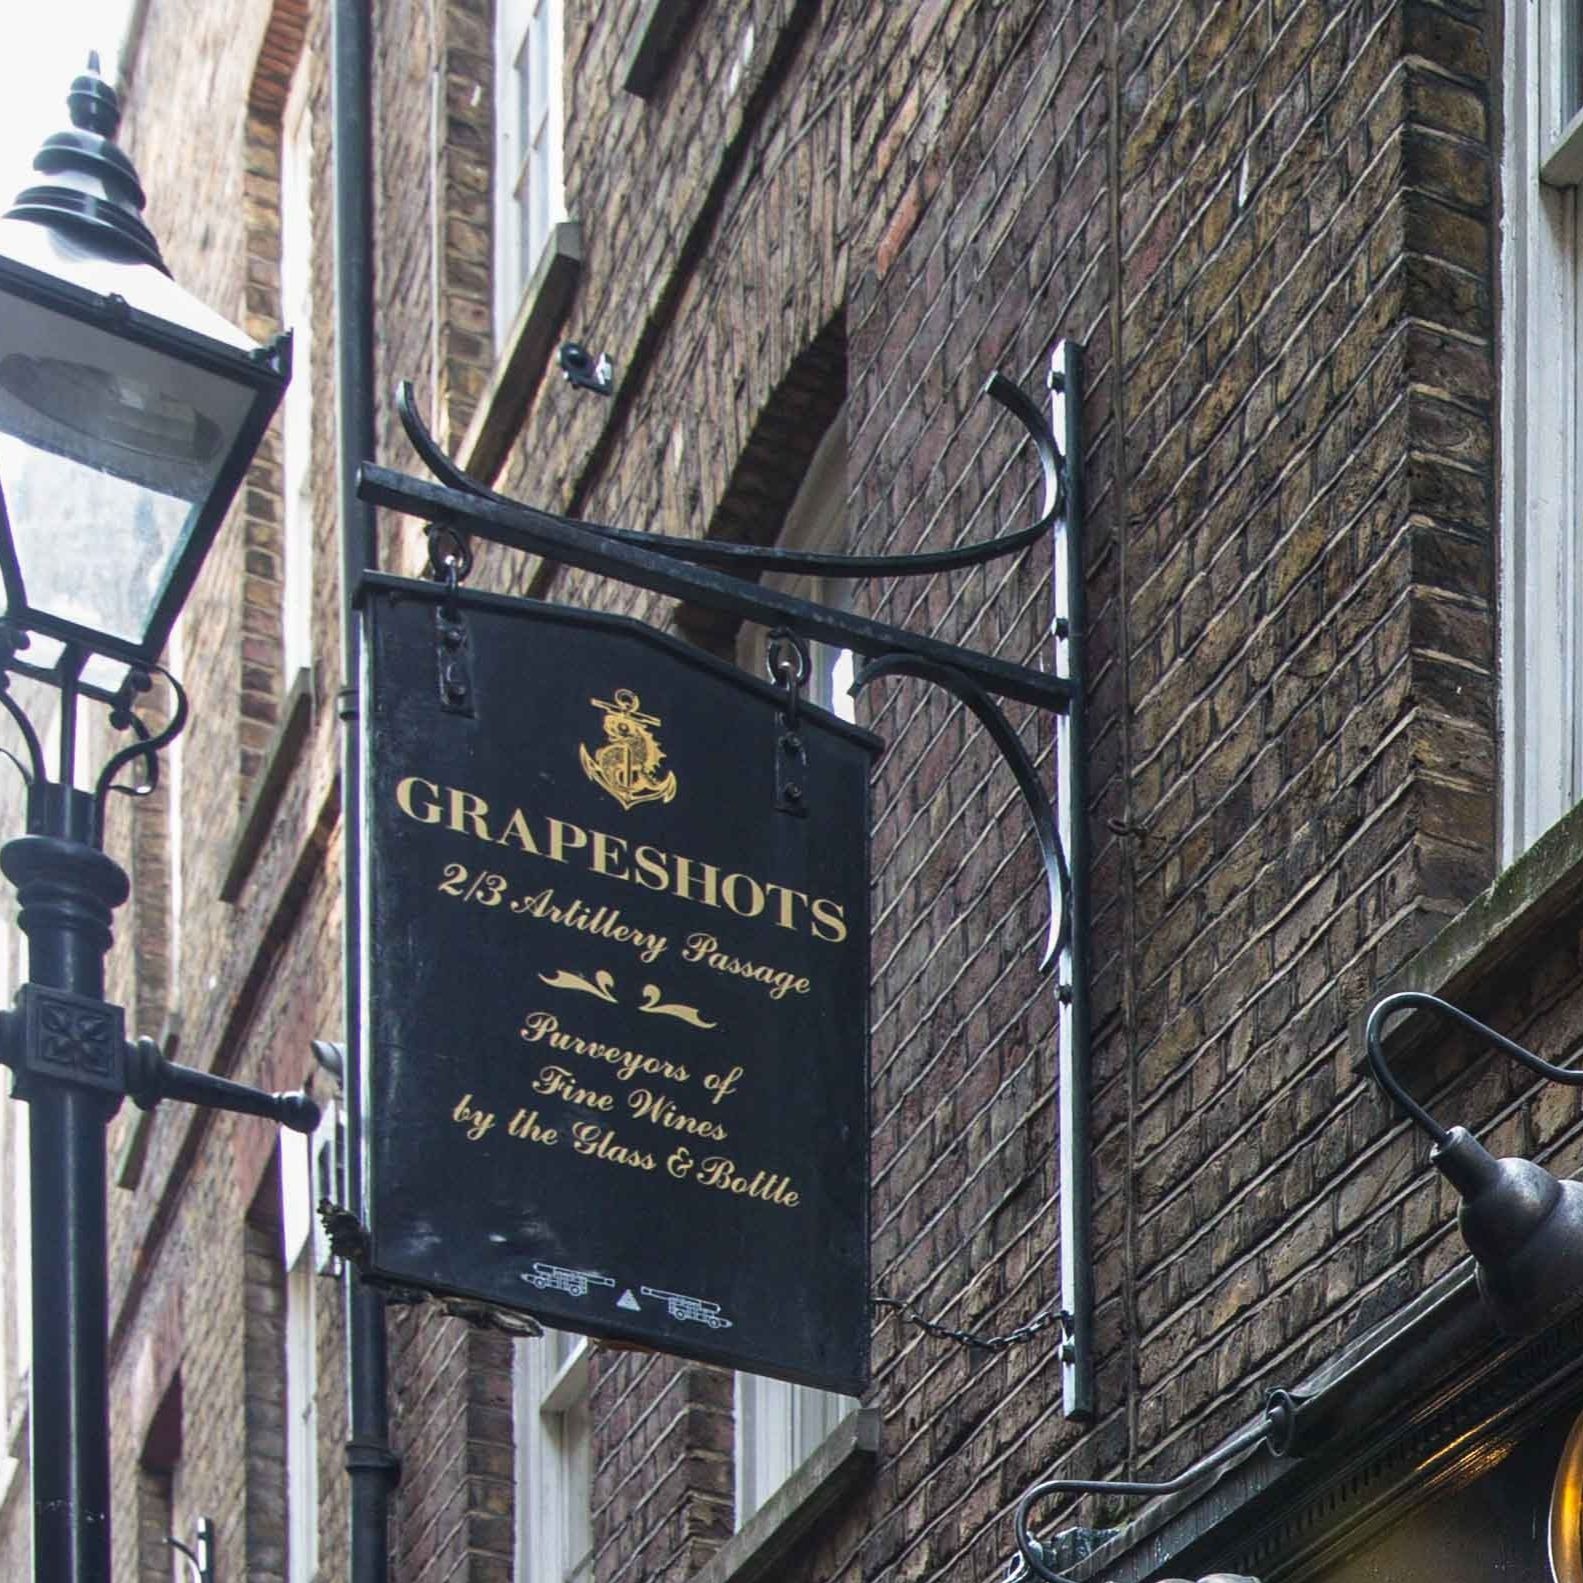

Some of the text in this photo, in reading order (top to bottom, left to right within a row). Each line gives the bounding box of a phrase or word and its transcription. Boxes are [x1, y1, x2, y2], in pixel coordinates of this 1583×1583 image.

[396, 776, 848, 943] GRAPESHOTS
[438, 862, 811, 999] 2/3 Artillery Passage
[520, 1012, 744, 1105] Purveyors of
[531, 1065, 729, 1143] Fine Wines
[451, 1093, 801, 1208] by the Glass & Bottle
